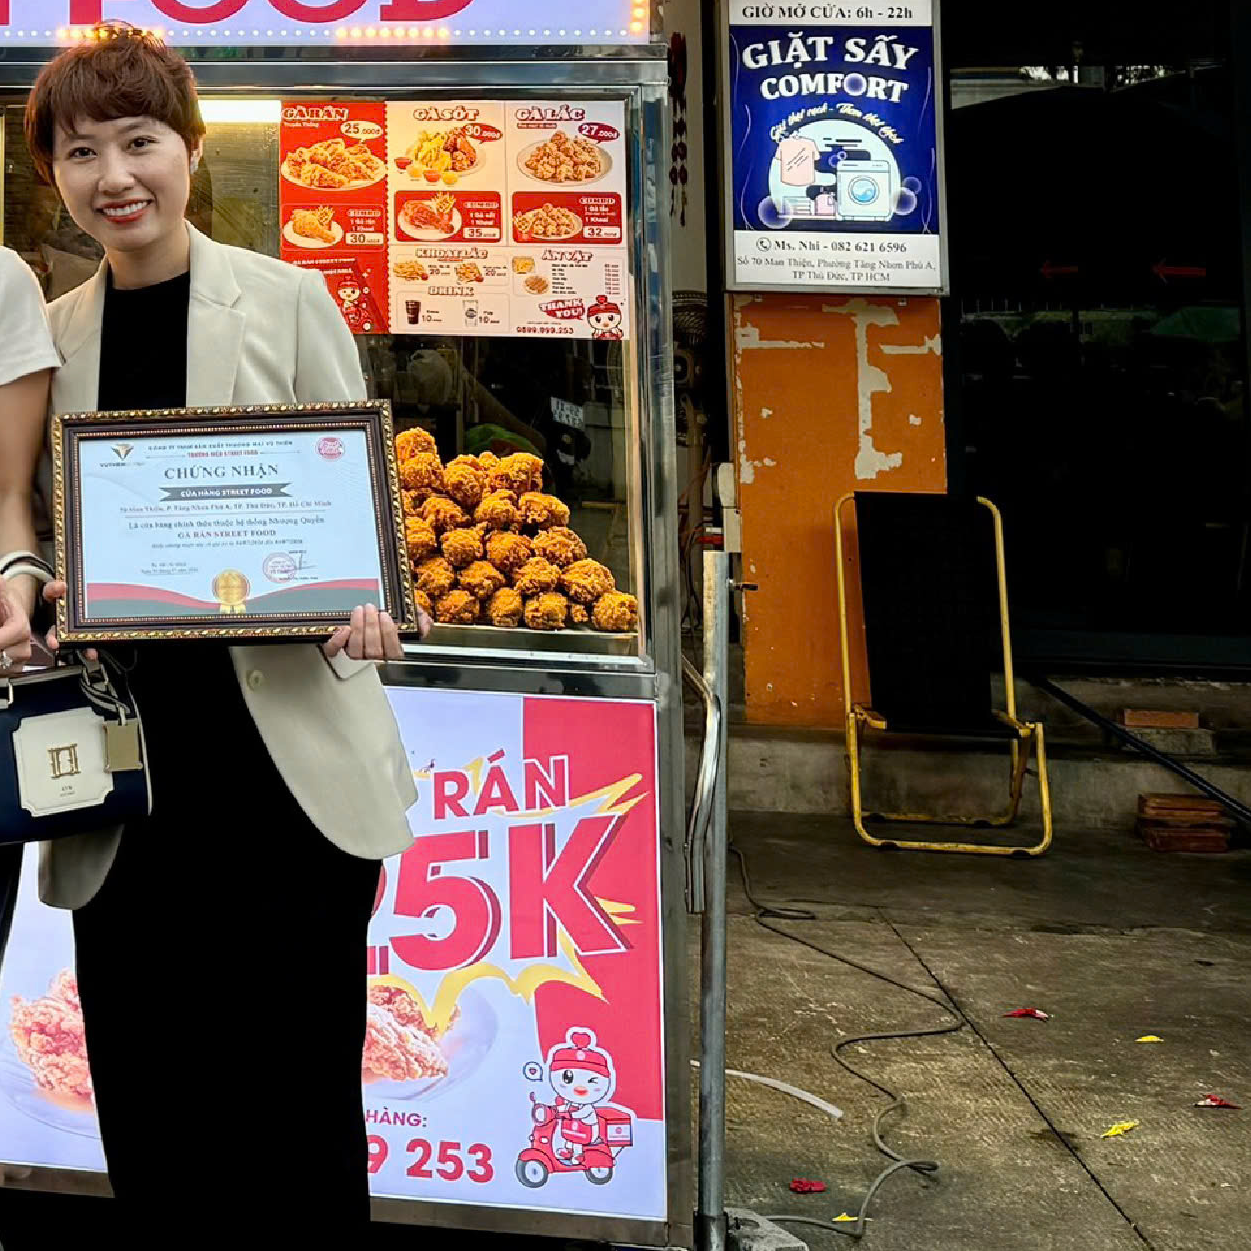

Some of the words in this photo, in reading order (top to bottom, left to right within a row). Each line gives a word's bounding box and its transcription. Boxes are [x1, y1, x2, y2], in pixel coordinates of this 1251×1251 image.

[742, 2, 775, 19] GIỜ
[778, 3, 807, 19] MỞ
[856, 6, 873, 19] 6h
[887, 6, 913, 19] 22h
[742, 31, 834, 70] GIẶT
[760, 73, 909, 103] COMFORT
[799, 240, 820, 251] Nhi
[831, 241, 851, 251] 082
[854, 241, 875, 252] 621
[879, 242, 907, 252] 6596
[164, 464, 226, 480] CHỨNG
[232, 464, 278, 479] NHẬN
[433, 748, 569, 820] RÁN
[373, 813, 635, 972] 5K
[406, 1138, 494, 1184] 253
